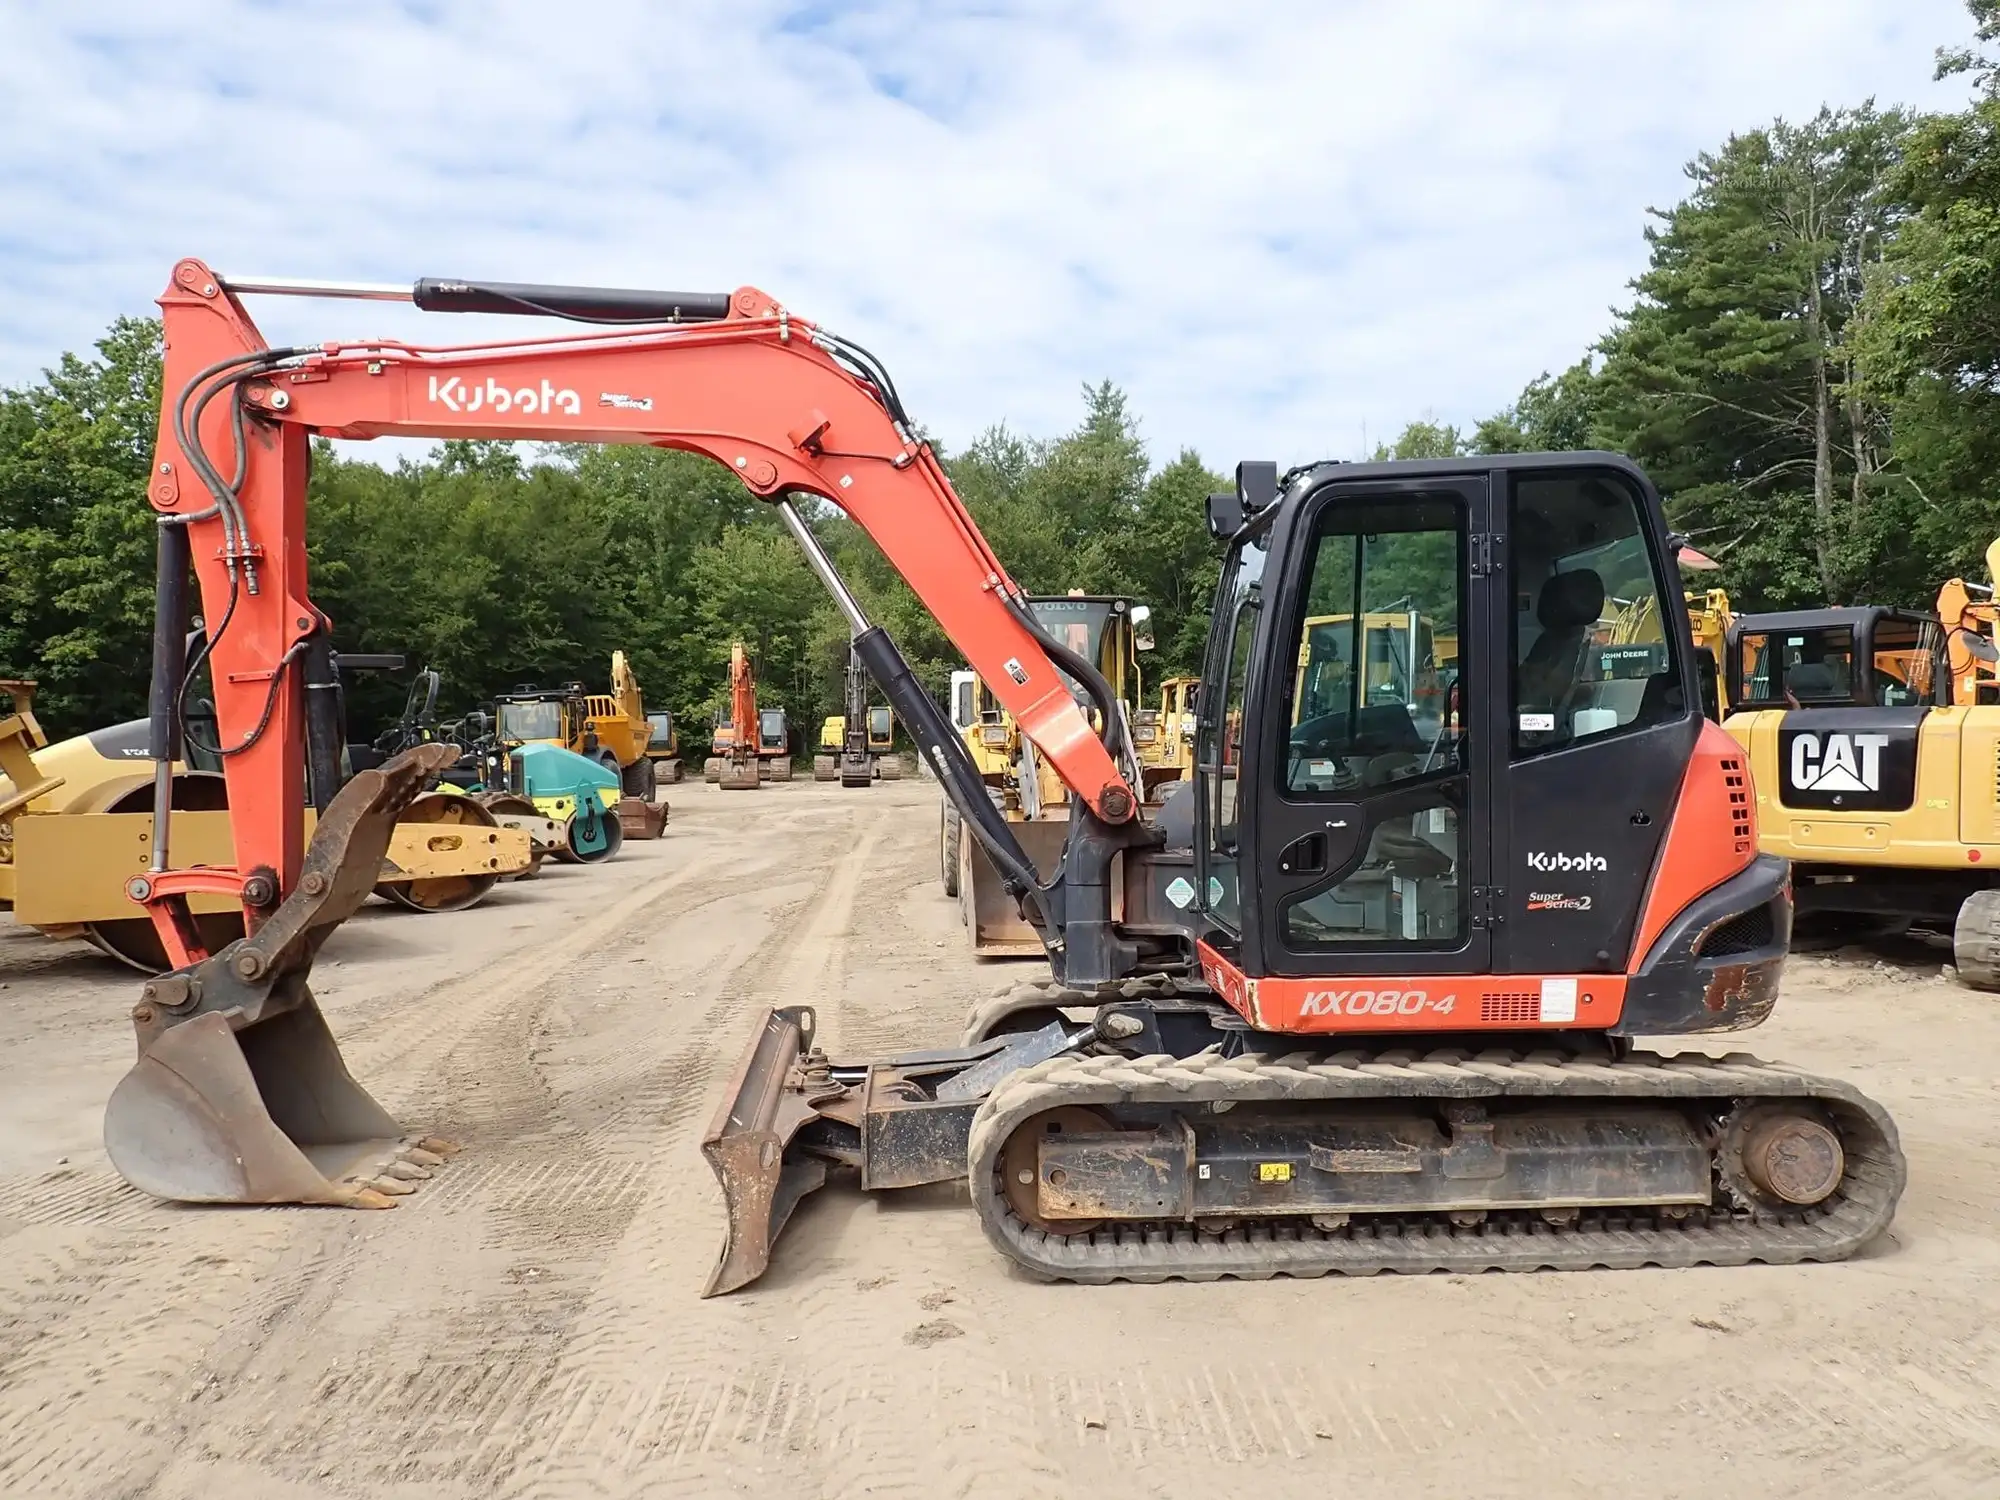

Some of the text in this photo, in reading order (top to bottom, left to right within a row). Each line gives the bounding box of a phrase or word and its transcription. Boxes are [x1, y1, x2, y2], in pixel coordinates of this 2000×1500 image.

[428, 376, 581, 415] Kubota
[600, 391, 633, 403] Super
[1034, 602, 1087, 611] VOLVO
[1601, 650, 1649, 660] JOHN DEERE
[1791, 734, 1889, 792] CAT
[1527, 852, 1607, 871] Kubota
[1528, 892, 1563, 903] Super
[1300, 991, 1456, 1016] KX080-4
